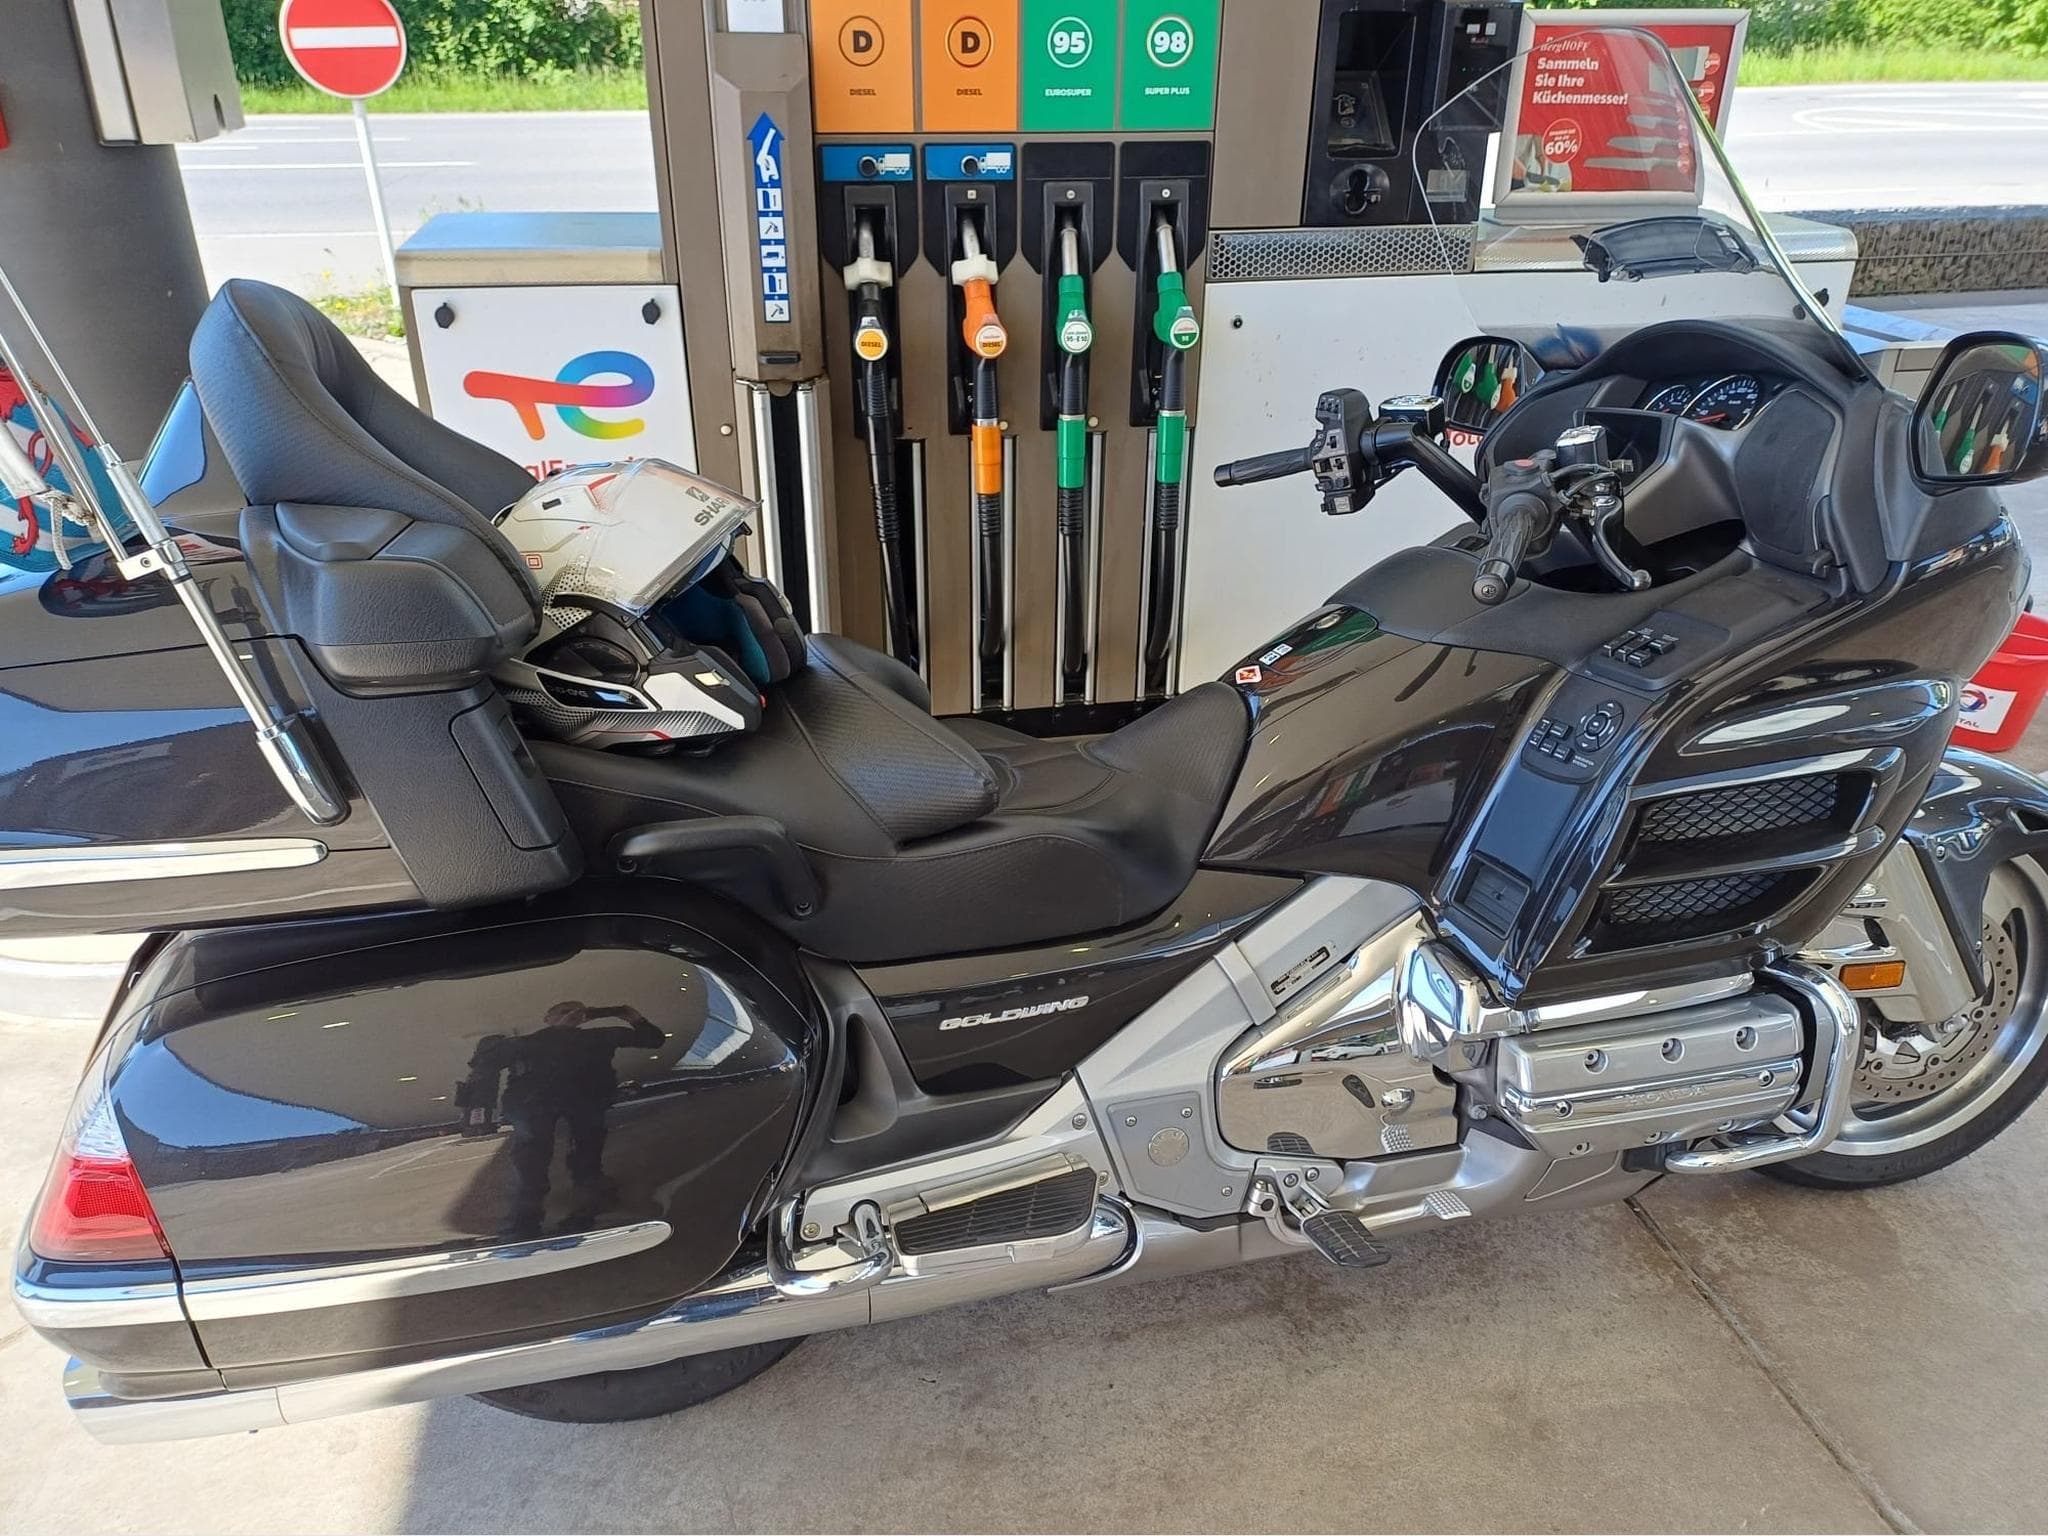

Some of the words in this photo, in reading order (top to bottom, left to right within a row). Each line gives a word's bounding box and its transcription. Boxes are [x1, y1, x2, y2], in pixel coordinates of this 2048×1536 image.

[853, 30, 873, 53] D
[961, 31, 981, 54] D
[1053, 31, 1086, 54] 95
[1153, 31, 1187, 53] 98
[1537, 57, 1599, 71] Sammeln
[1535, 75, 1554, 87] Sie
[1557, 75, 1585, 87] Ihre
[850, 88, 877, 96] DIESEL
[956, 88, 983, 96] DIESEL
[1045, 88, 1092, 97] EUROSUPER
[1144, 87, 1170, 95] SUPER
[1171, 87, 1190, 95] PLUS
[1532, 90, 1629, 105] Küchenmesser!
[1544, 139, 1578, 155] 60%
[939, 996, 1090, 1031] GOLDWING
